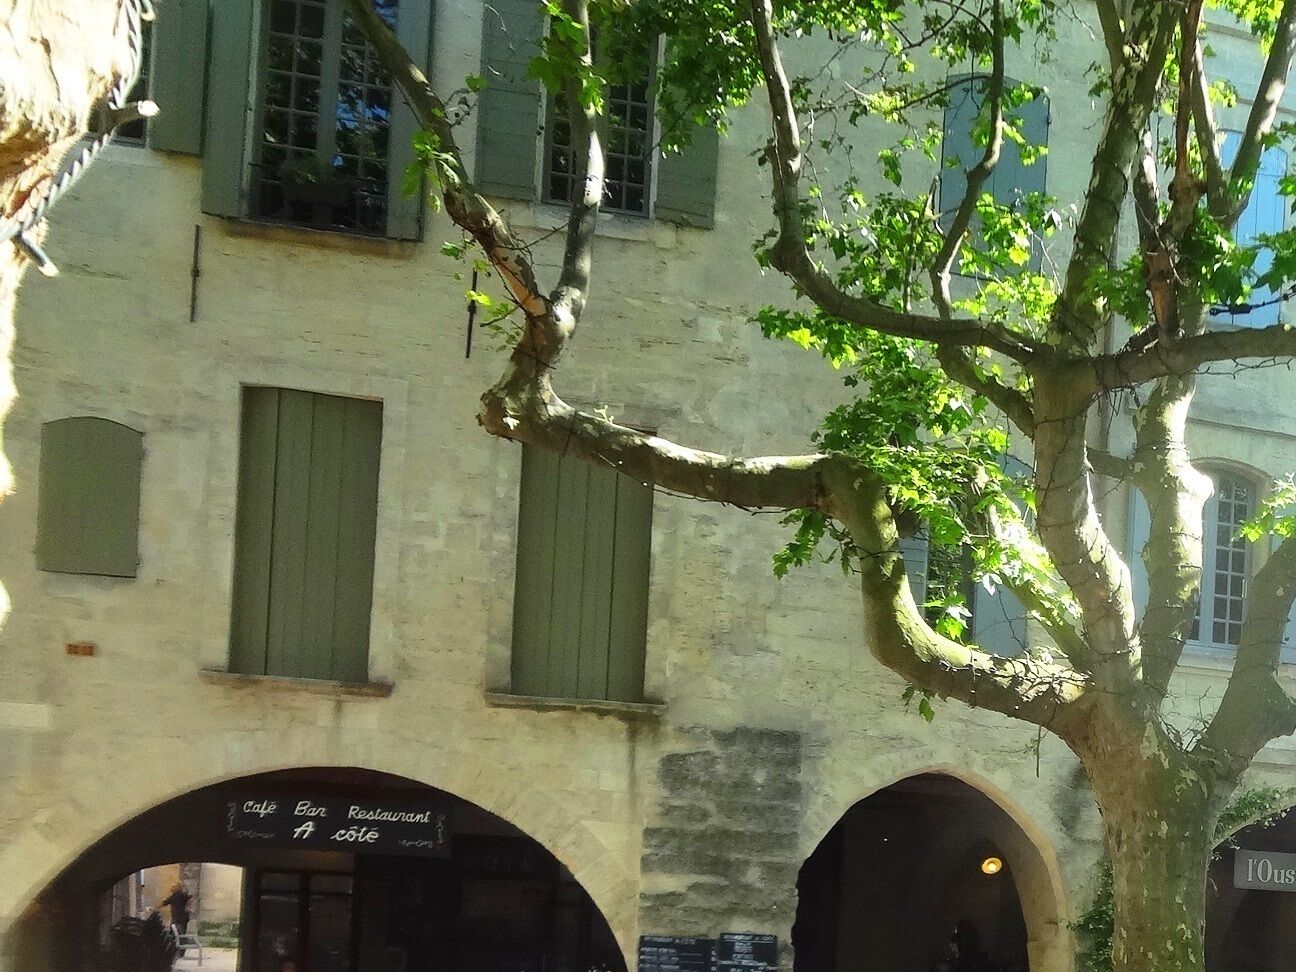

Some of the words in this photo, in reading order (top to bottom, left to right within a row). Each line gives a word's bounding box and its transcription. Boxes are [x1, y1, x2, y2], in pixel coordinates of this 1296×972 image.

[243, 800, 278, 818] Café
[294, 801, 327, 818] Bar
[348, 805, 431, 823] Restaurant
[293, 821, 316, 839] A
[330, 826, 379, 843] côté
